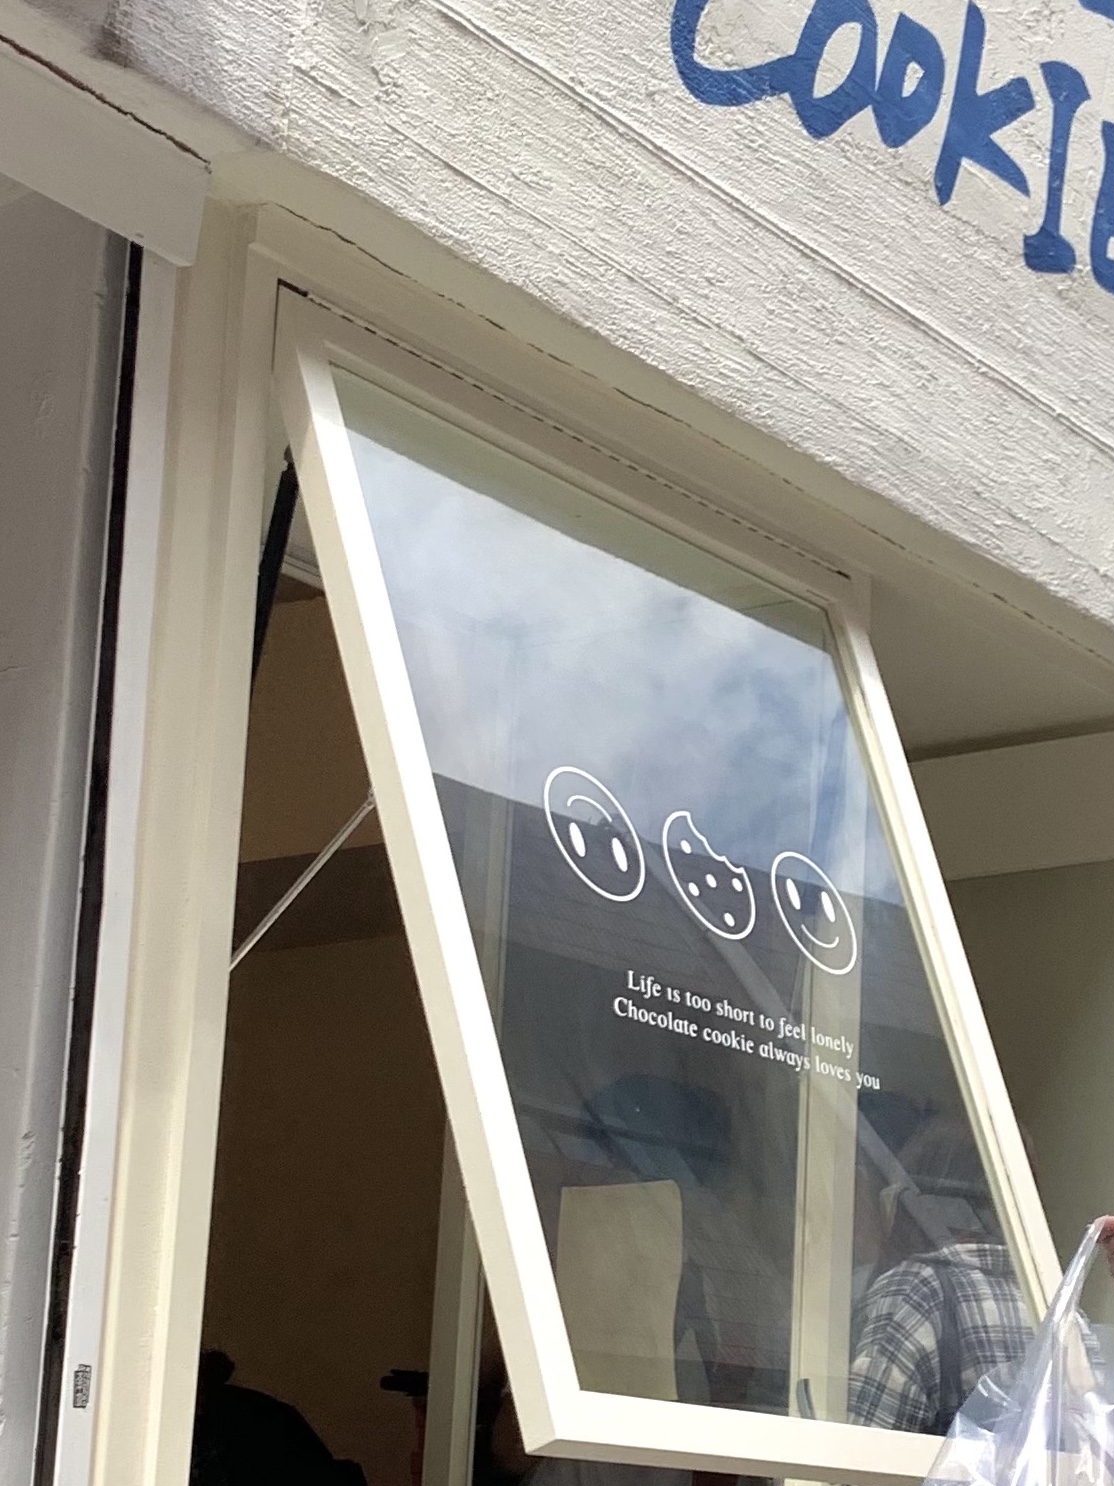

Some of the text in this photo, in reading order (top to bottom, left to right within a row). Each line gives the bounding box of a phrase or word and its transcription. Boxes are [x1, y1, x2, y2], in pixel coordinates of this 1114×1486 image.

[613, 996, 881, 1090] Chocolate cookie always loves you
[627, 969, 854, 1059] Life is too short to feel lonely
